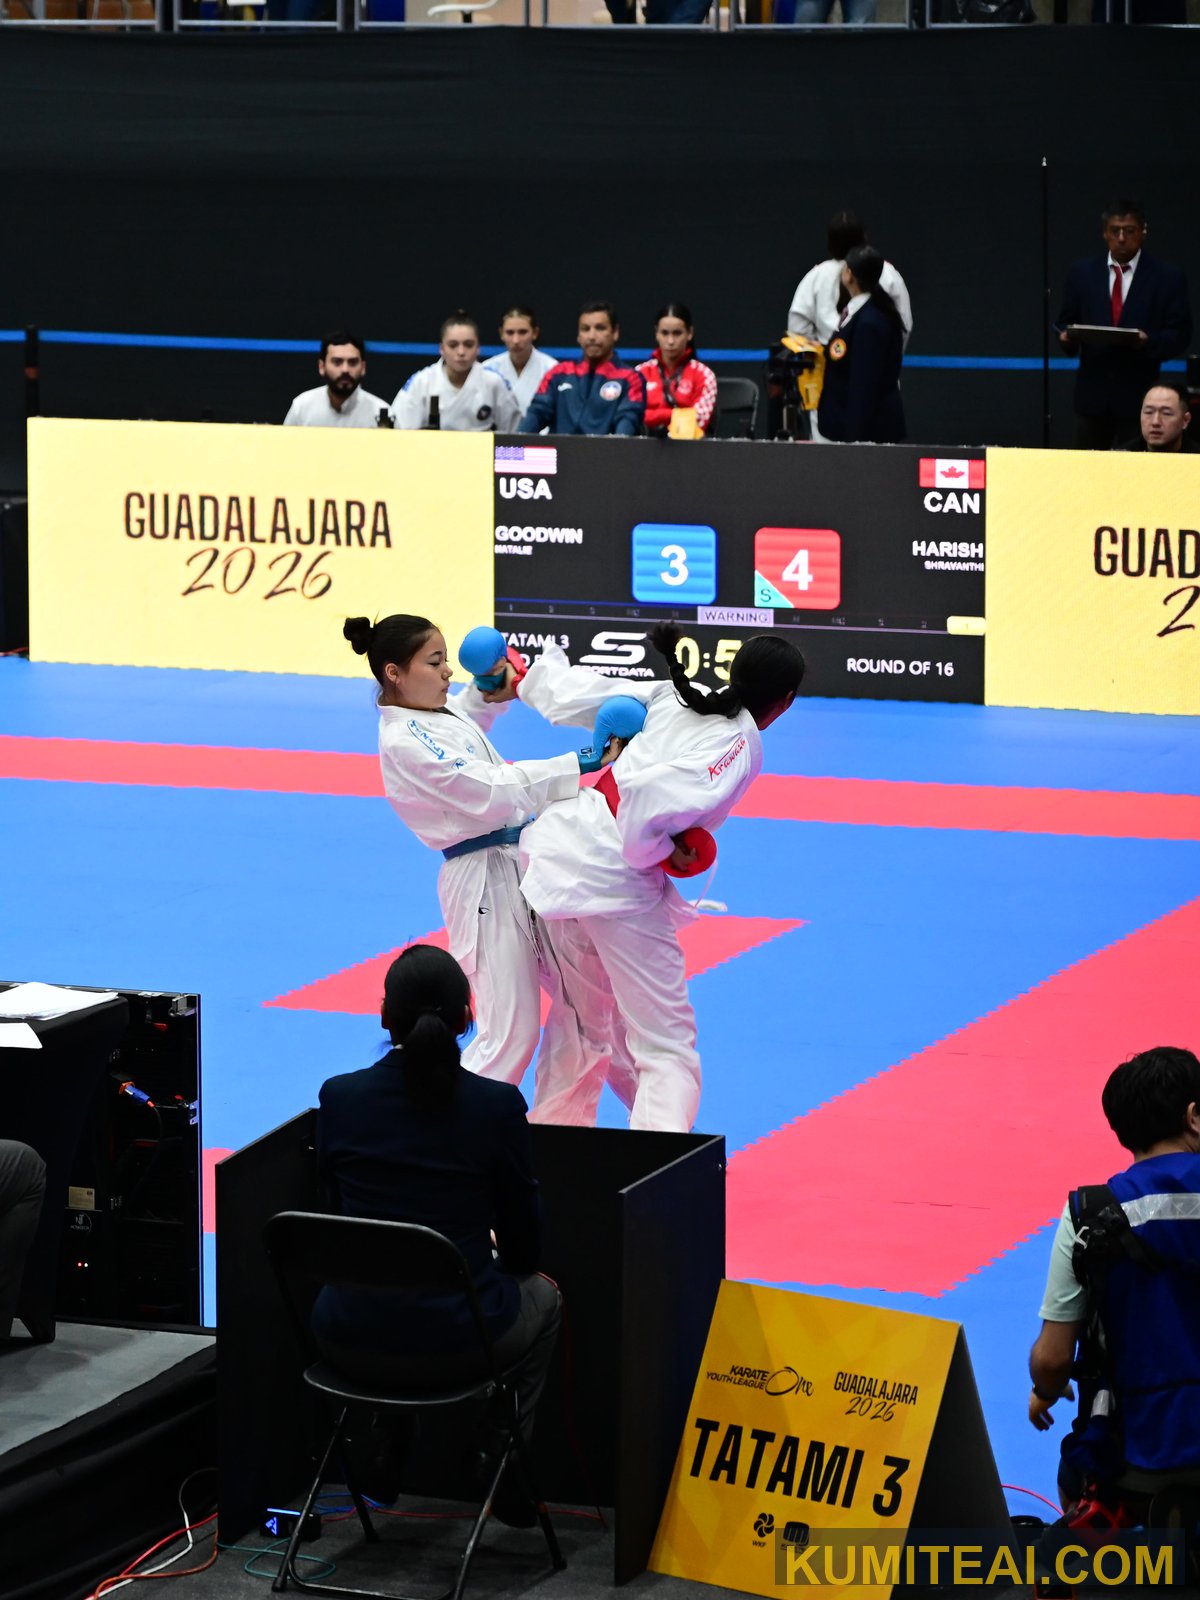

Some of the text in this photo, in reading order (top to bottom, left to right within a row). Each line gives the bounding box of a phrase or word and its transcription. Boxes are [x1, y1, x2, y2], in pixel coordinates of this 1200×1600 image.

[499, 477, 553, 500] USA
[923, 491, 980, 514] CAN
[124, 491, 392, 549] GUADALAJARA
[495, 525, 583, 544] GOODWIN
[912, 540, 984, 559] HARISH
[181, 547, 333, 600] 2026
[660, 544, 689, 586] 3
[781, 548, 814, 591] 4
[924, 560, 985, 572] SHRAVANTHI
[760, 588, 772, 602] S
[705, 610, 768, 624] WARNING
[560, 634, 570, 650] 3
[847, 658, 954, 677] ROUND OF 16
[705, 1371, 766, 1391] YOUTH LEAGUE
[729, 1365, 770, 1381] KARATE
[765, 1366, 814, 1397] One
[833, 1371, 919, 1405] GUADALAJARA
[845, 1396, 897, 1422] 2026
[689, 1418, 911, 1518] TATAMI 3
